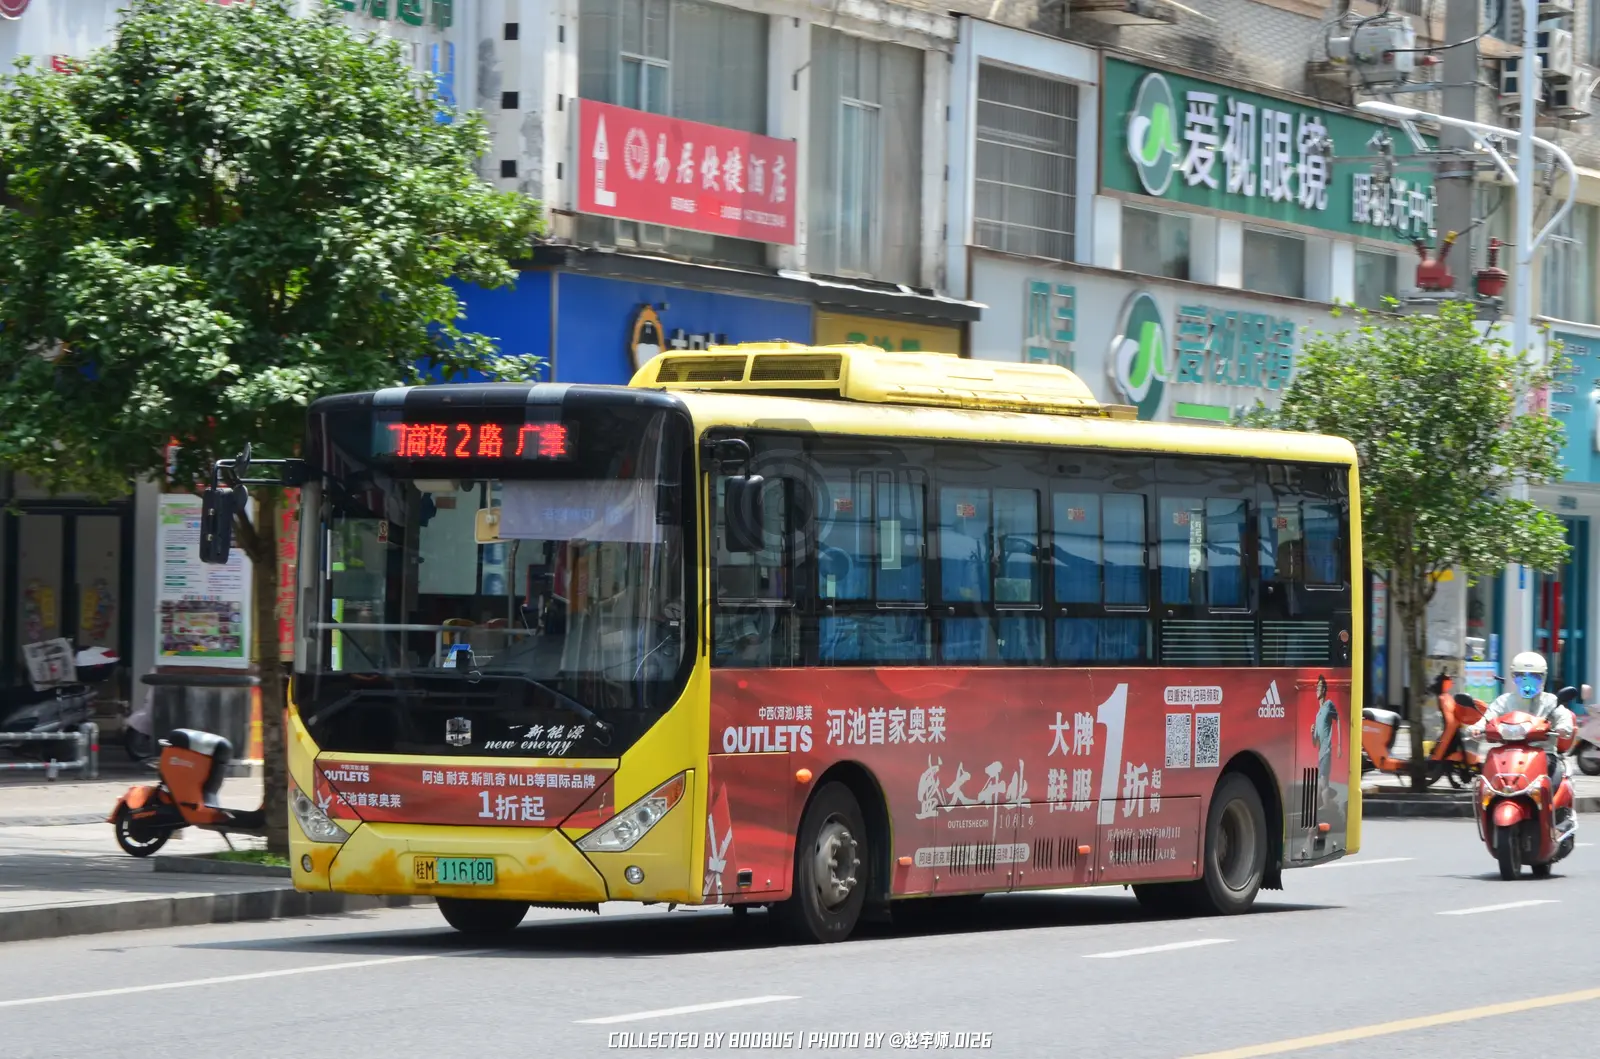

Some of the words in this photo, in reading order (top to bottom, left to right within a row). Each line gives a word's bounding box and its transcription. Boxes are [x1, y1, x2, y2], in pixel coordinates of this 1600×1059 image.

[1184, 90, 1328, 210] 爱视眼镜
[826, 706, 946, 745] 河池首家奥莱
[1258, 706, 1285, 718] adidas
[484, 740, 517, 749] new
[520, 740, 575, 756] energy
[722, 725, 813, 753] OUTLETS
[1048, 712, 1094, 756] 大牌
[324, 770, 370, 783] OUTLETS
[422, 770, 444, 785] 阿迪
[446, 771, 469, 786] 耐克
[471, 772, 506, 787] 斯凯奇
[509, 773, 596, 789] MLB等国际品牌
[1047, 768, 1092, 813] 鞋服
[337, 791, 401, 808] 河池首家奥莱
[478, 790, 545, 821] 1折起
